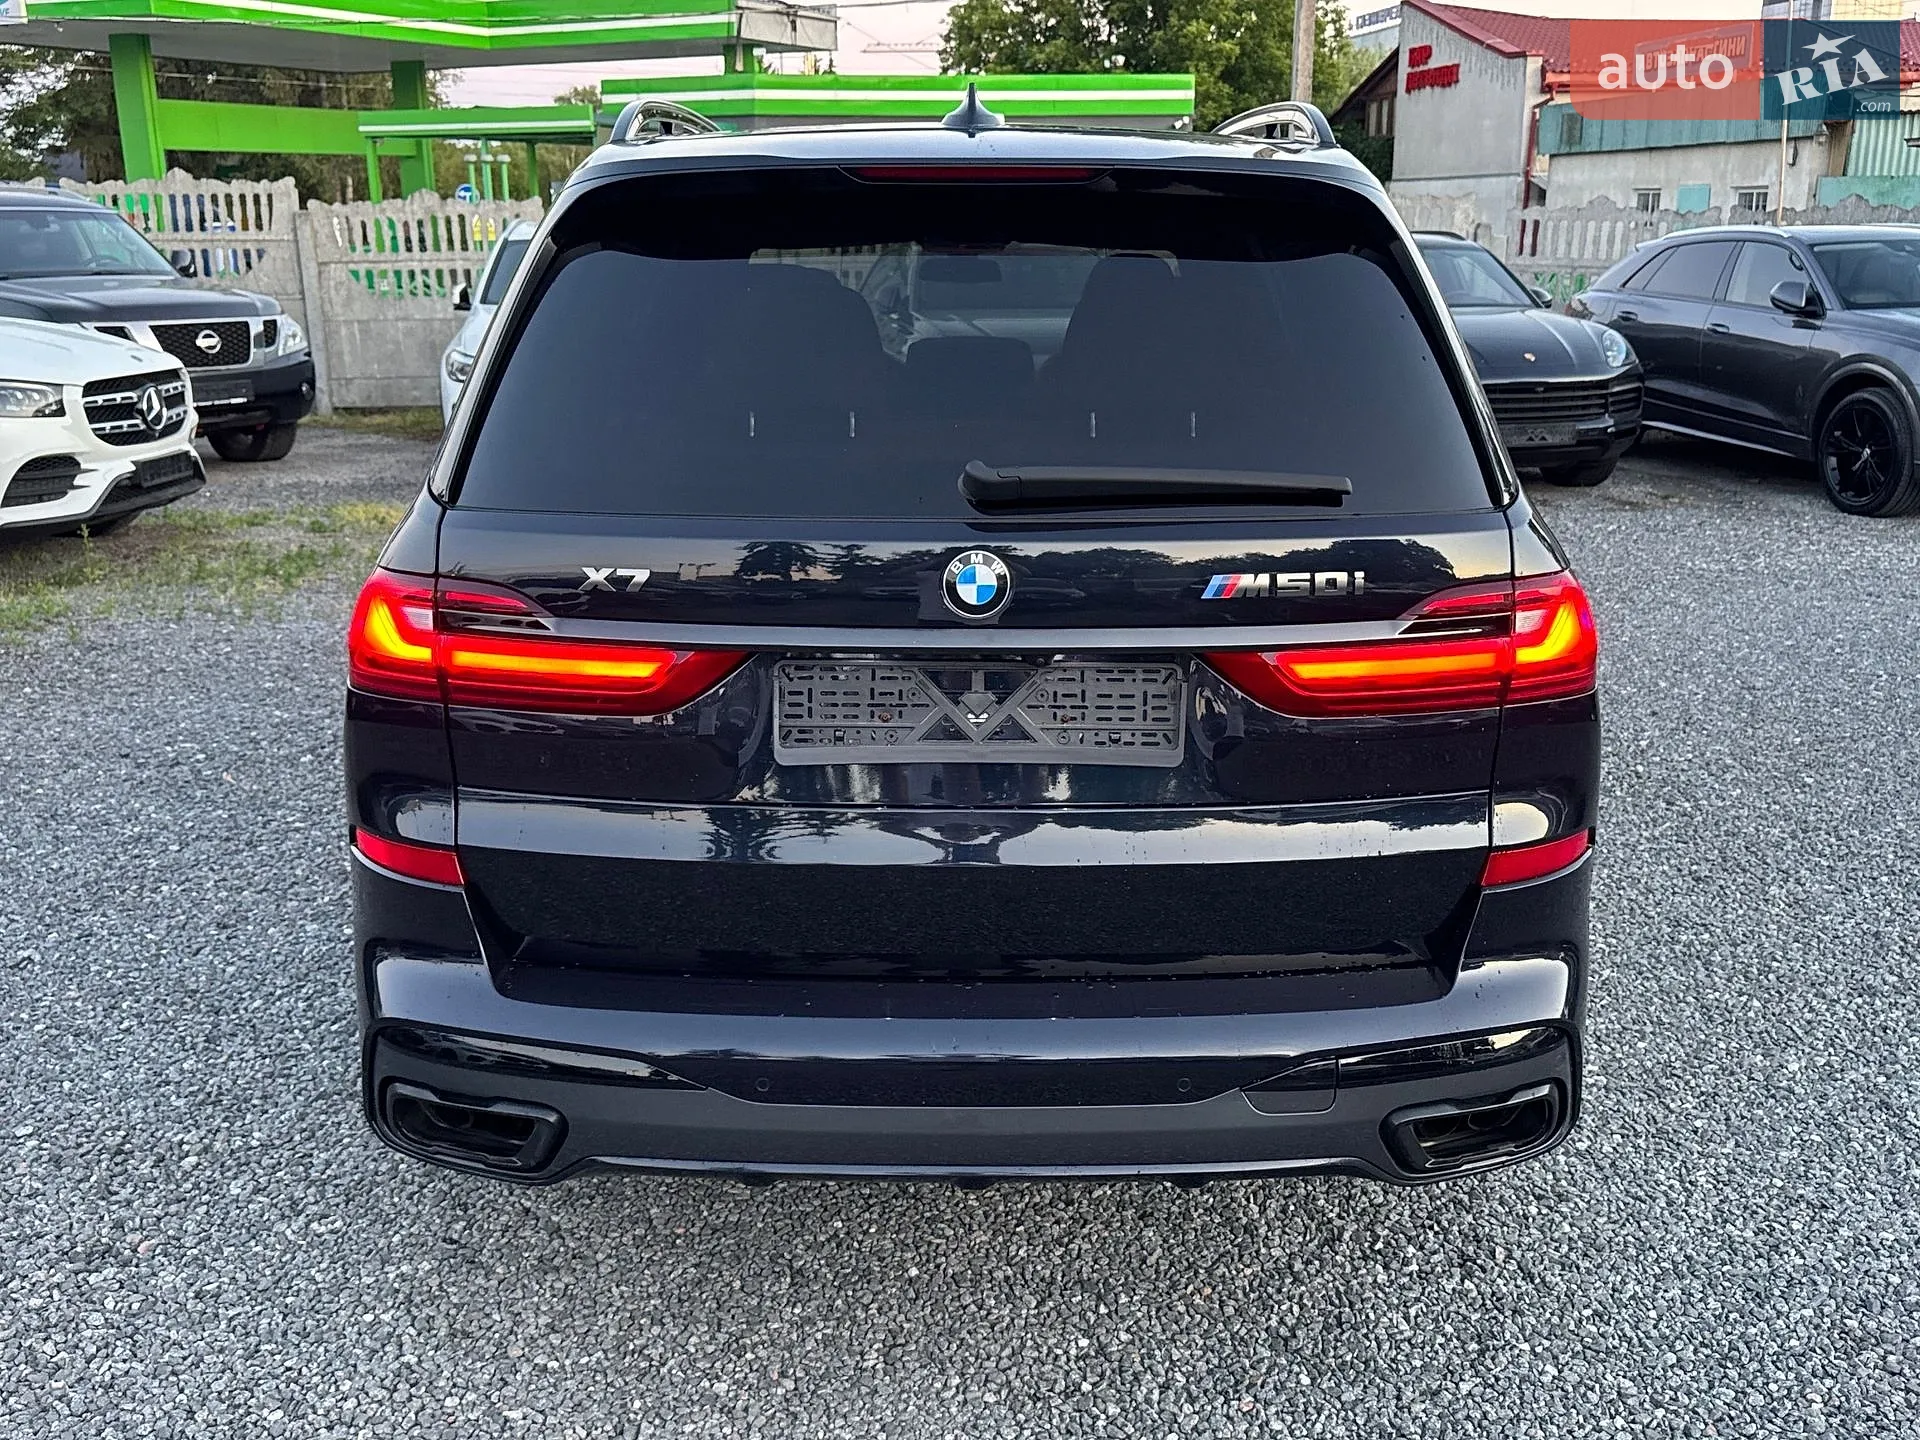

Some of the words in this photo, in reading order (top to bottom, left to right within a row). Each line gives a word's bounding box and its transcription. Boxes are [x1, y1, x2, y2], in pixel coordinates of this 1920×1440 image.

[950, 553, 1005, 575] BMW
[577, 567, 651, 592] X7
[1230, 571, 1365, 598] M50i
